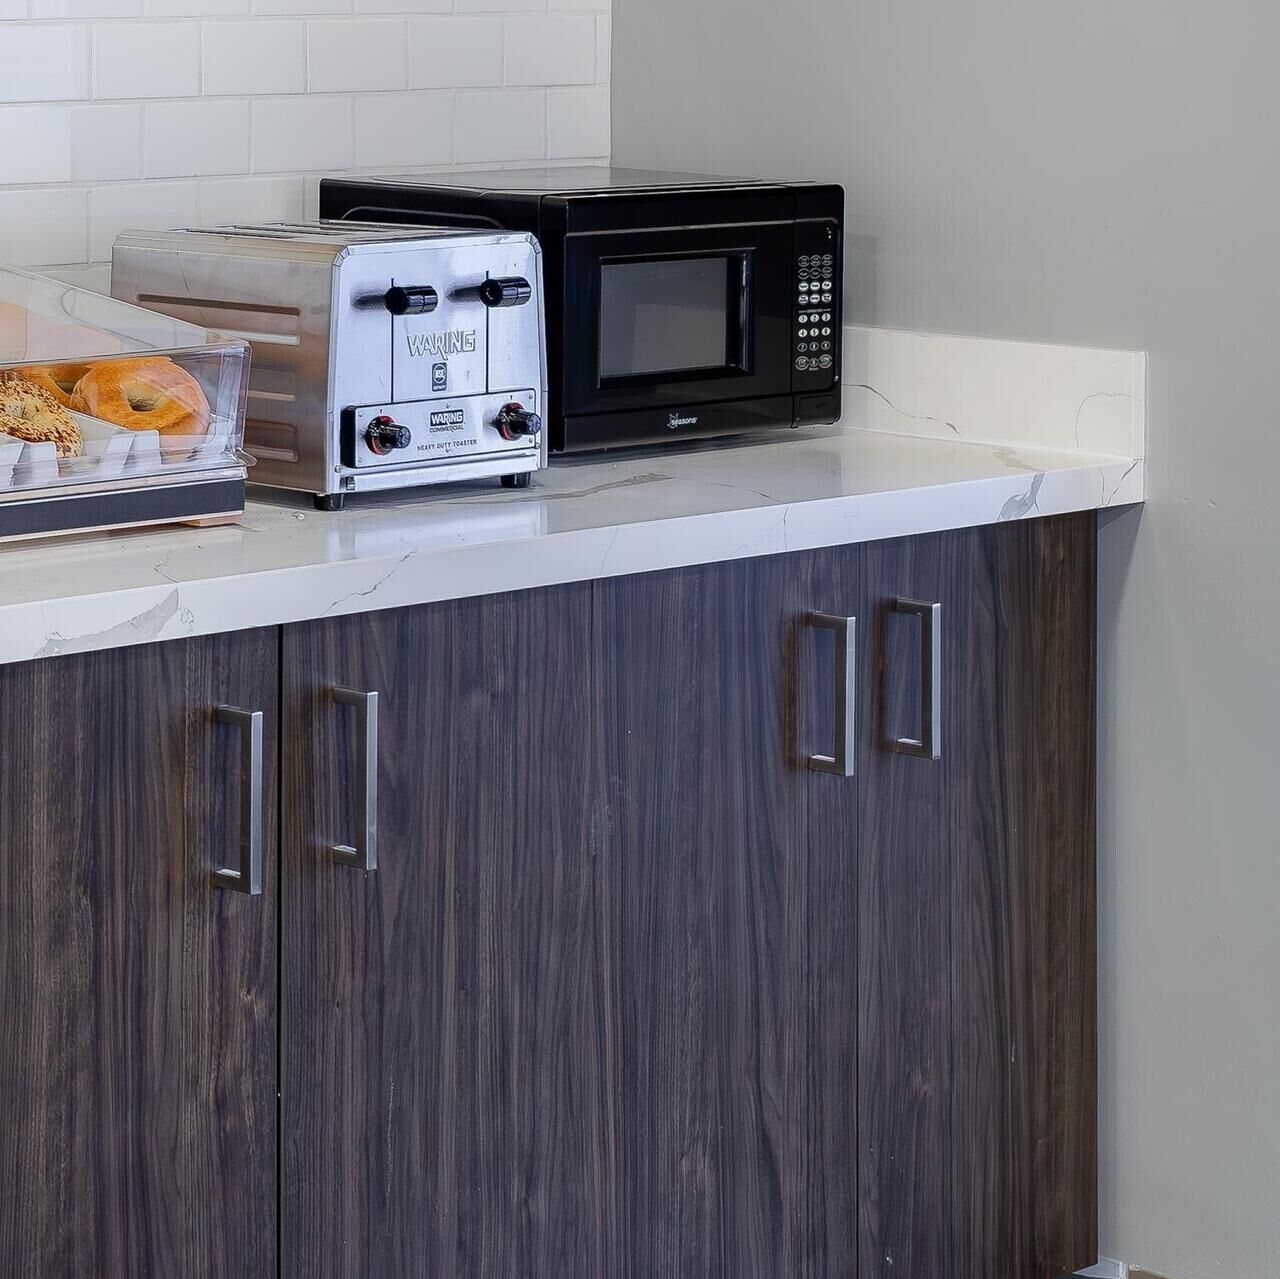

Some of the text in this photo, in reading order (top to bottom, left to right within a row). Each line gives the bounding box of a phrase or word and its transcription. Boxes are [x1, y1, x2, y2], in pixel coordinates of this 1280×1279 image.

[407, 329, 476, 361] WARING
[431, 411, 463, 425] WARING
[437, 441, 452, 449] DUTY
[453, 439, 478, 447] TOASTER
